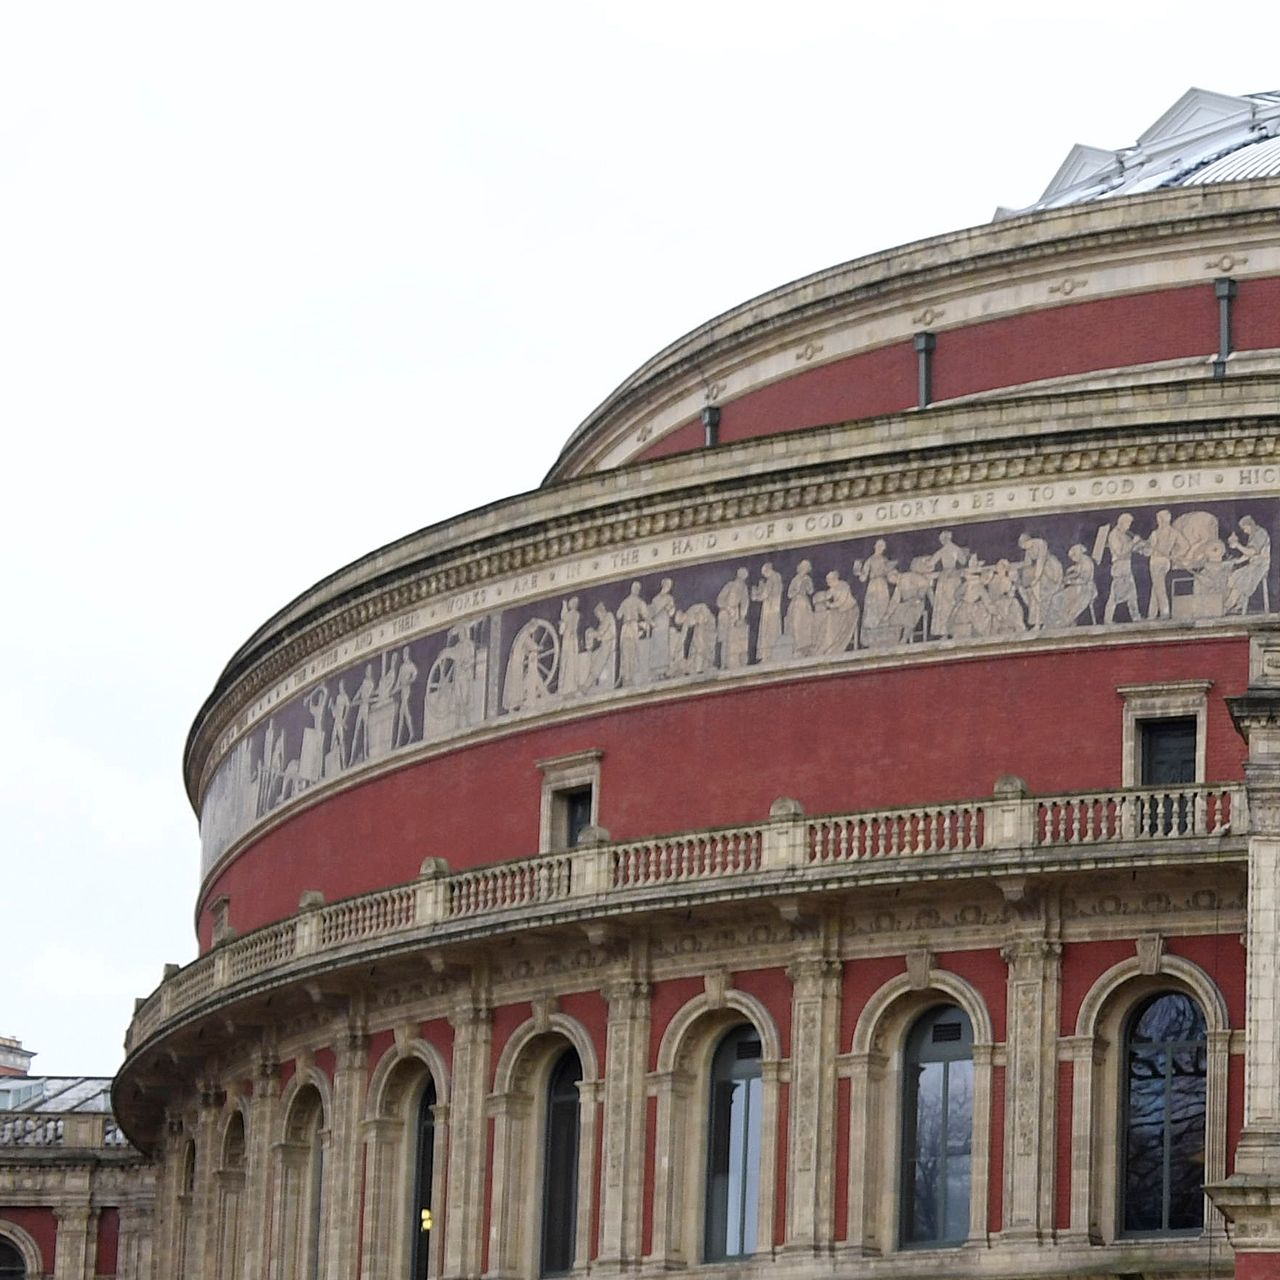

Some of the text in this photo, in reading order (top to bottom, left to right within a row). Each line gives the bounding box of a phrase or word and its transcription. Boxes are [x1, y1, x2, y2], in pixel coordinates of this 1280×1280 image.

[513, 574, 538, 593] ARE
[610, 549, 640, 568] THE
[755, 523, 775, 541] OF
[875, 498, 940, 522] GLORY
[972, 492, 994, 510] BE
[1029, 486, 1055, 502] TO
[1172, 474, 1200, 490] ON
